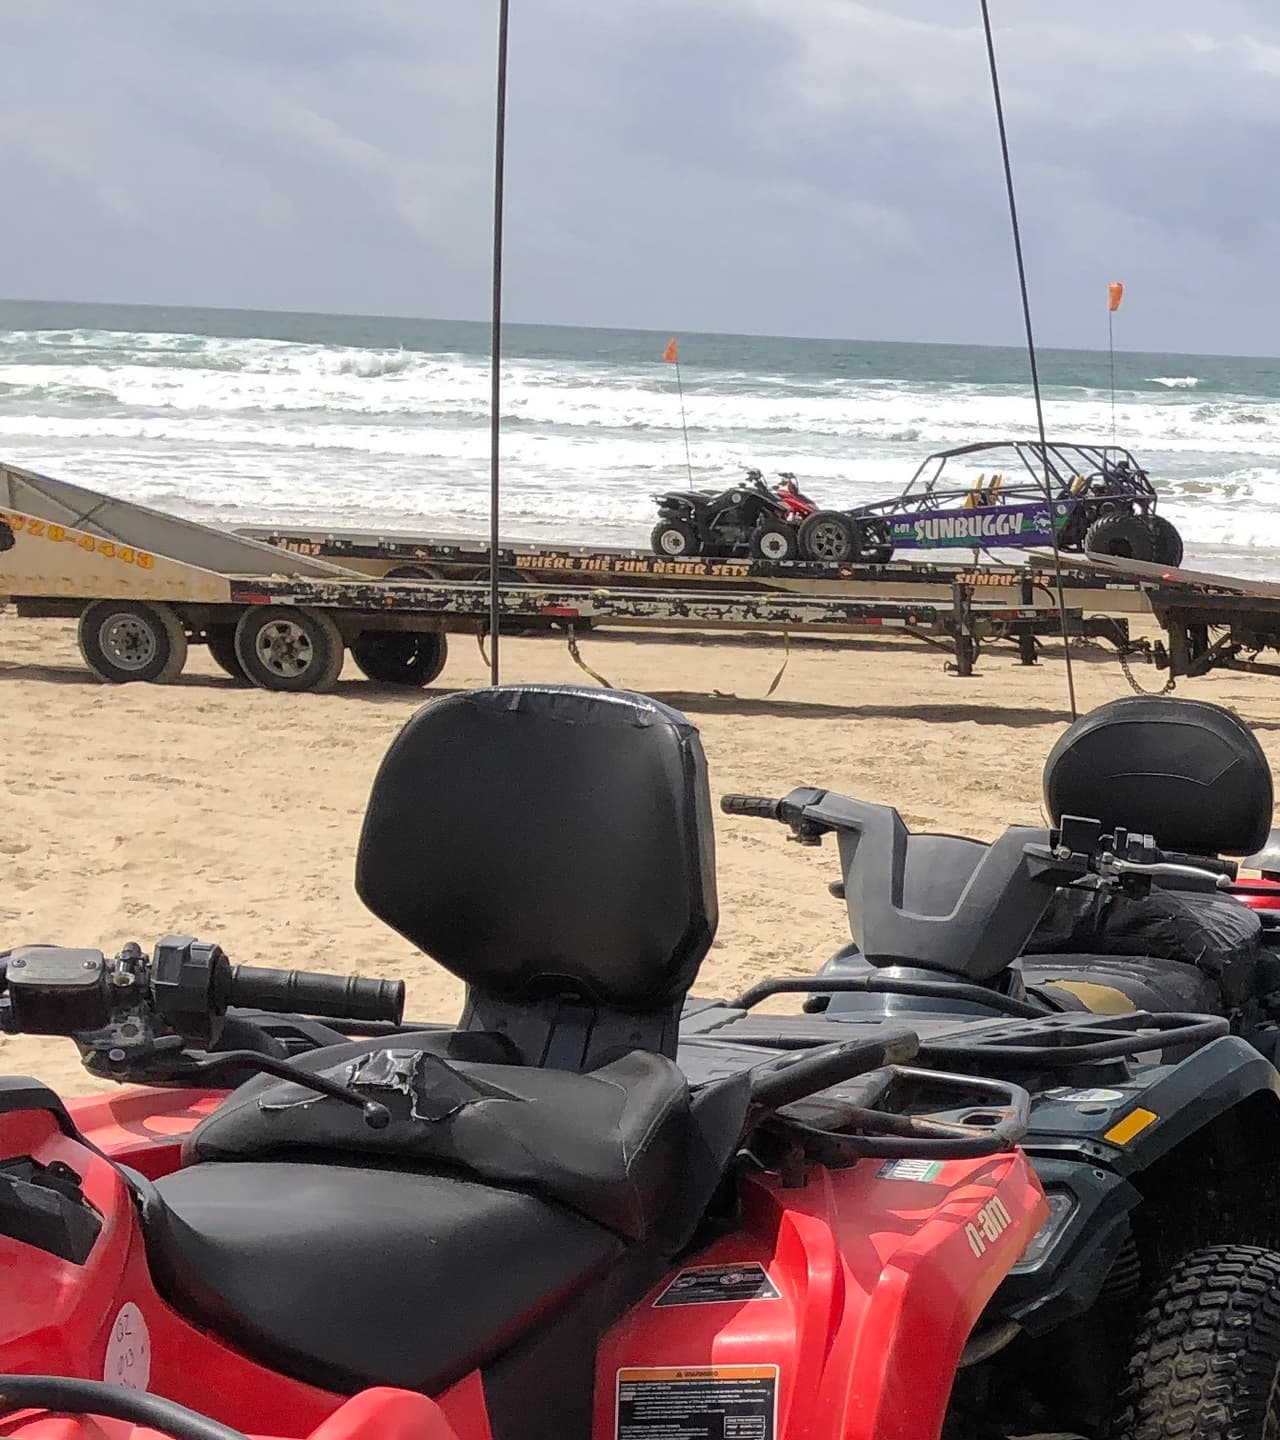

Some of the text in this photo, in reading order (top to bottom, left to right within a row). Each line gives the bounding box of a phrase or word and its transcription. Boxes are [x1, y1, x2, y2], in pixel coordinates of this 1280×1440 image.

[914, 512, 1024, 540] SUNBUGGY
[516, 555, 574, 570] WHERE
[580, 557, 609, 571] THE
[653, 560, 705, 575] NEVER
[711, 564, 749, 576] SETS
